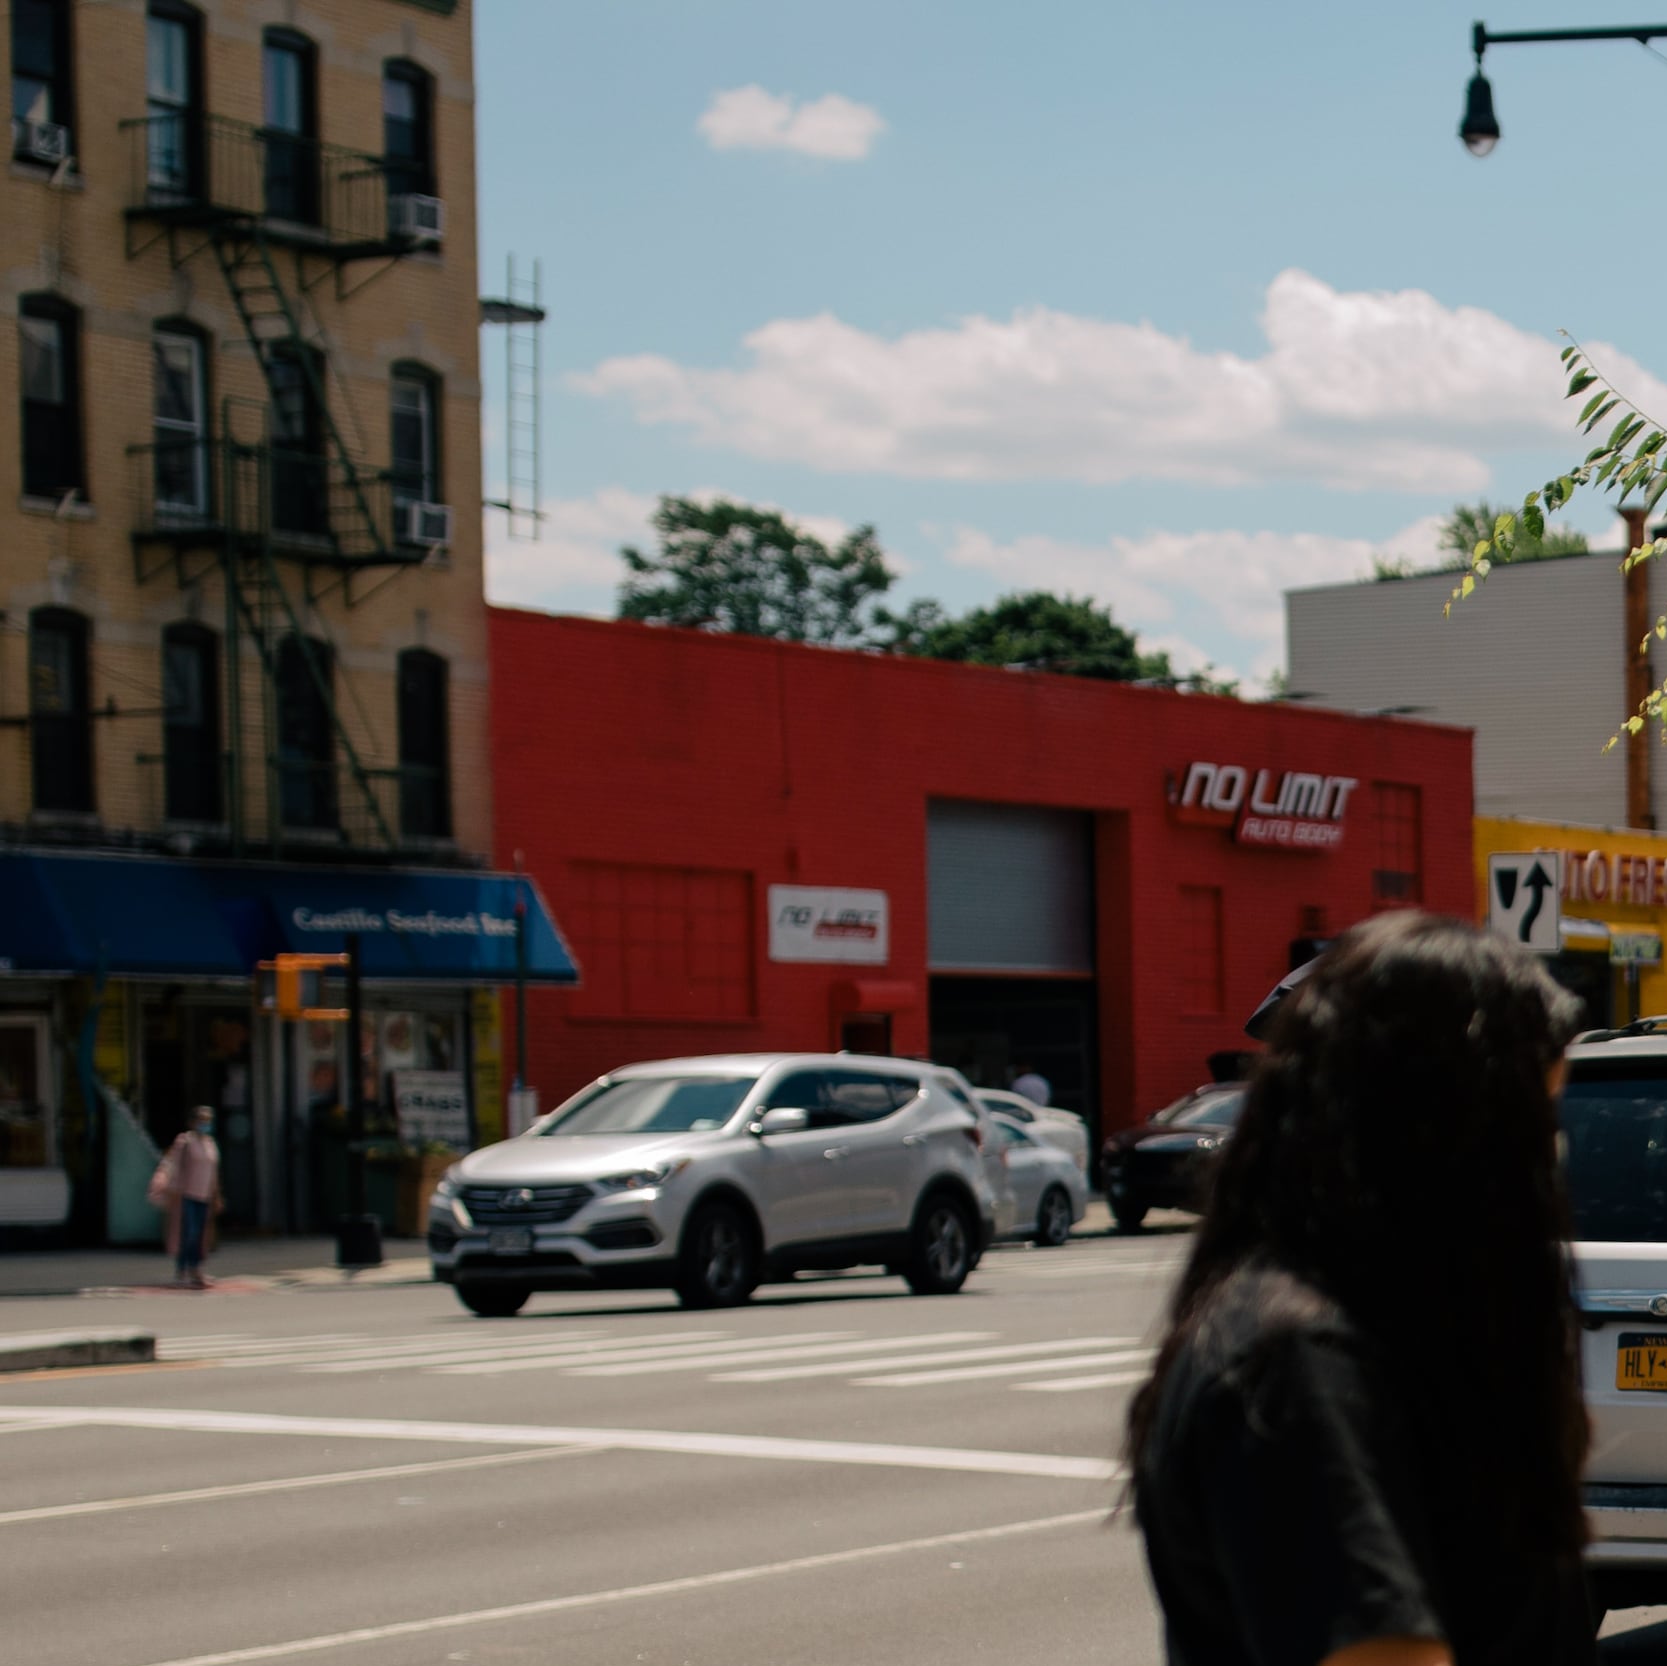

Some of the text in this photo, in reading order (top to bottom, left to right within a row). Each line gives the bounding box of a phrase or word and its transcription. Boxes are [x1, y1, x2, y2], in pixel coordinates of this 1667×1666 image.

[1181, 761, 1359, 820] NO LIMIT
[1241, 817, 1343, 846] AUTO BODY
[292, 906, 383, 932] Castillo
[386, 909, 477, 937] Seafood
[777, 904, 814, 928] NO
